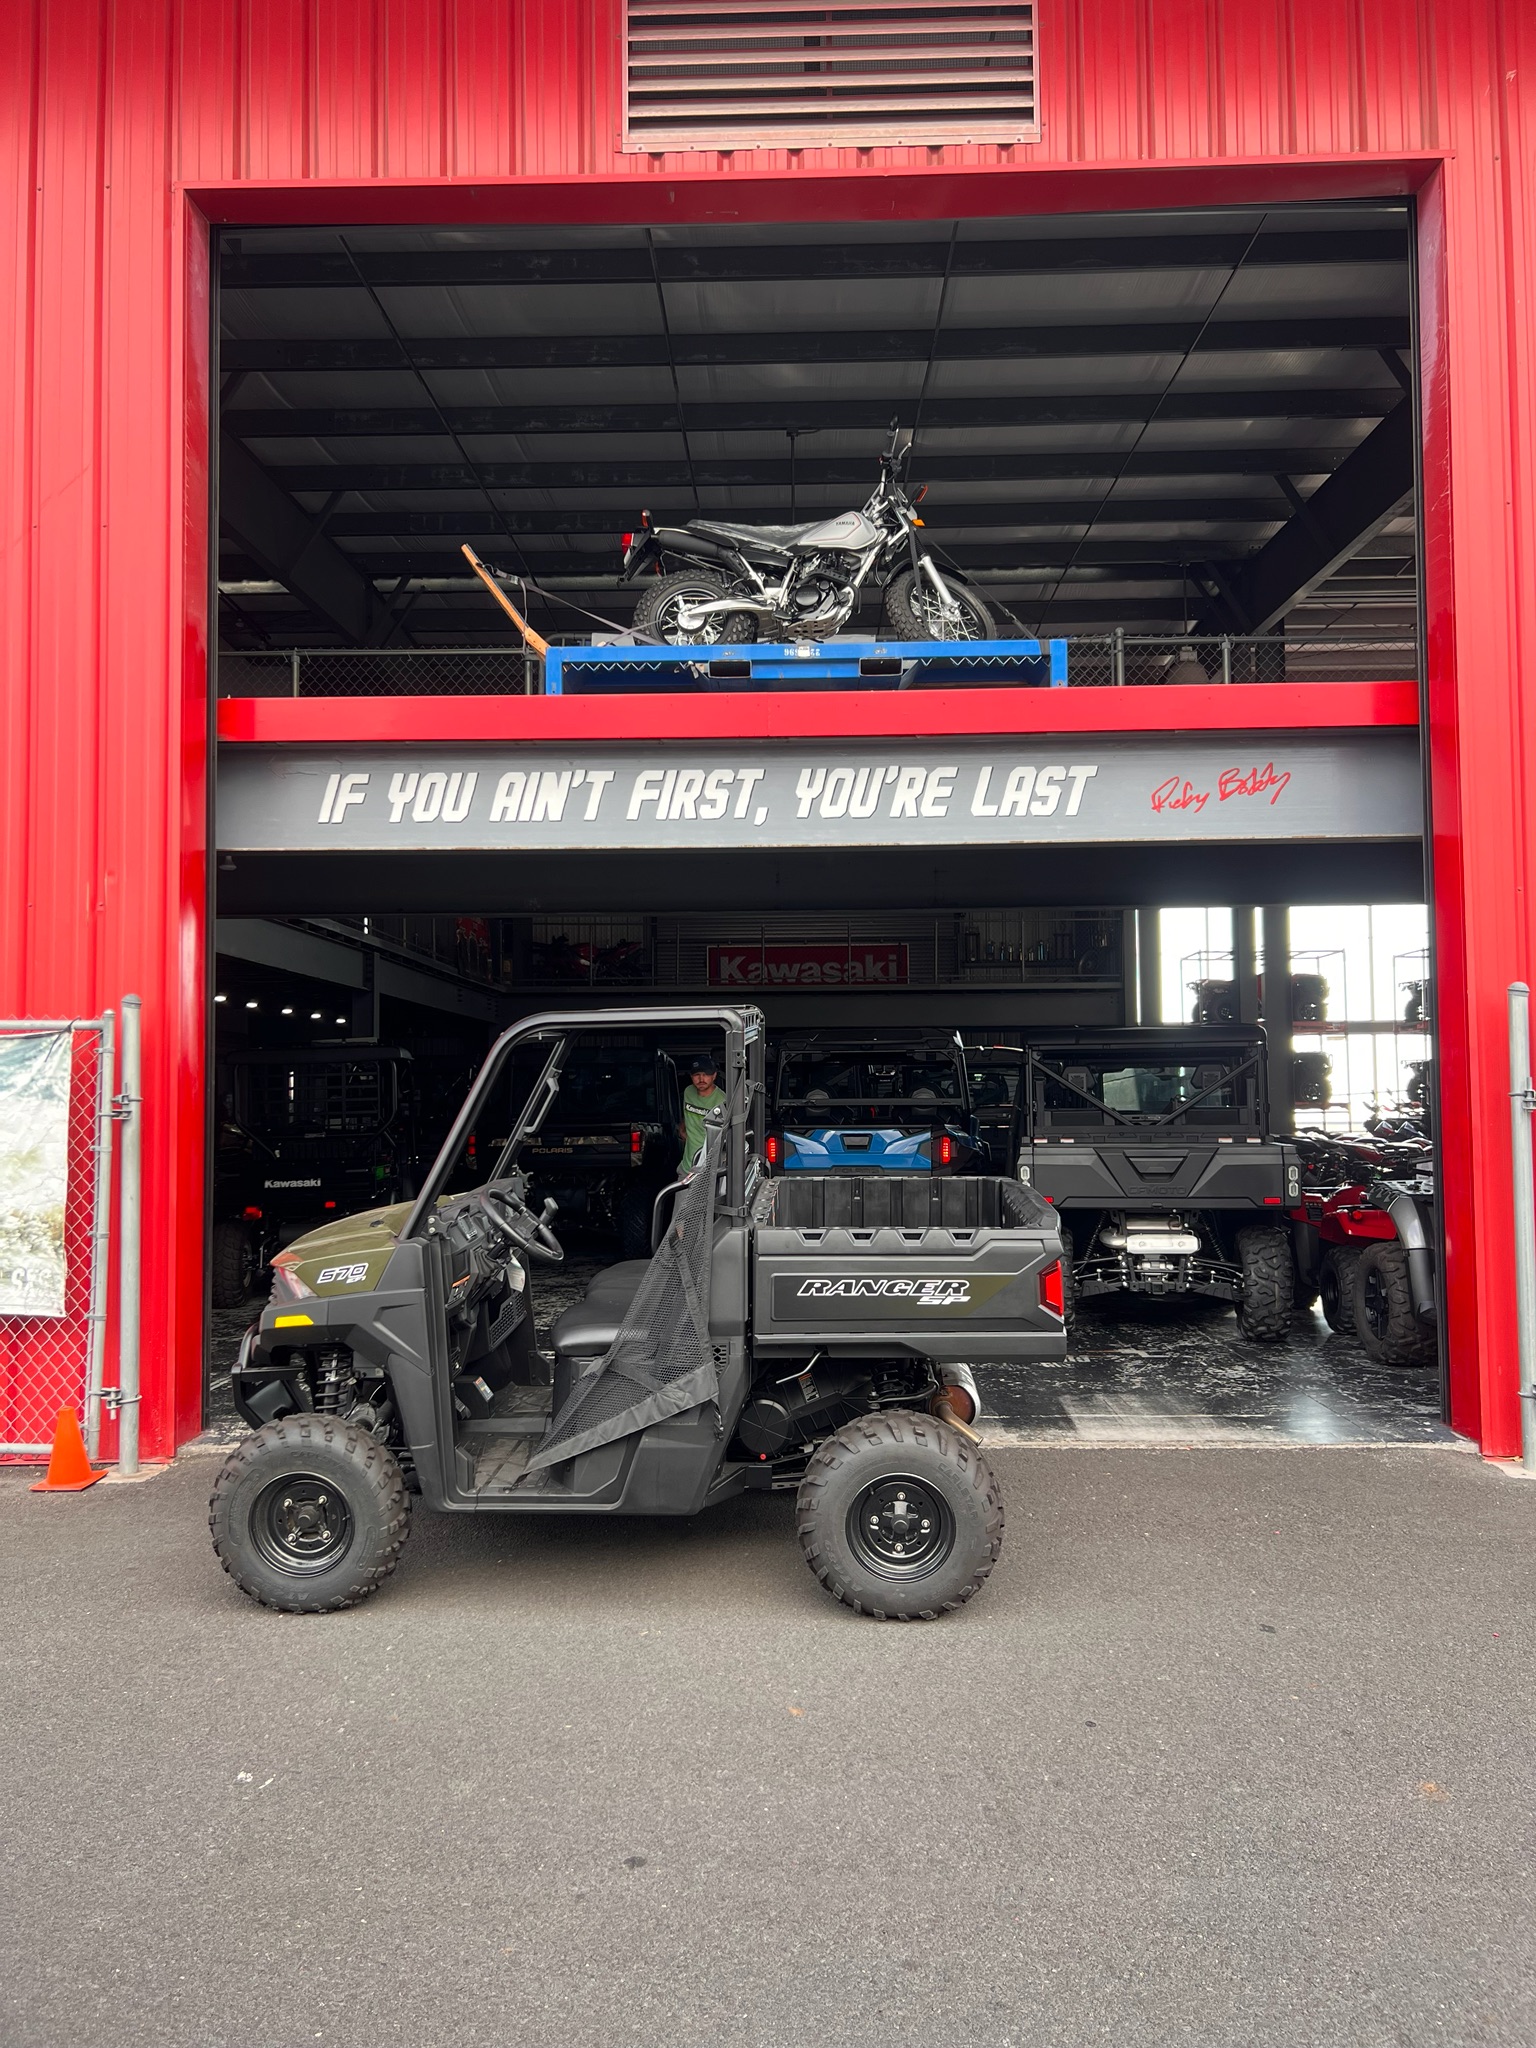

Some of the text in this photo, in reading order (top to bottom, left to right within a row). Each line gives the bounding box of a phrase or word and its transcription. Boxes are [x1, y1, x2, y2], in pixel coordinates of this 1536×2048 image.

[317, 765, 1098, 827] IF YOU AIN'T FIRST, YOU'RE LAST
[719, 954, 898, 983] Kawasaki
[264, 1178, 321, 1188] Kawasaki
[1128, 1185, 1187, 1195] CFMOTO
[316, 1262, 370, 1284] 570
[797, 1279, 970, 1297] RANGER
[916, 1295, 972, 1305] SP
